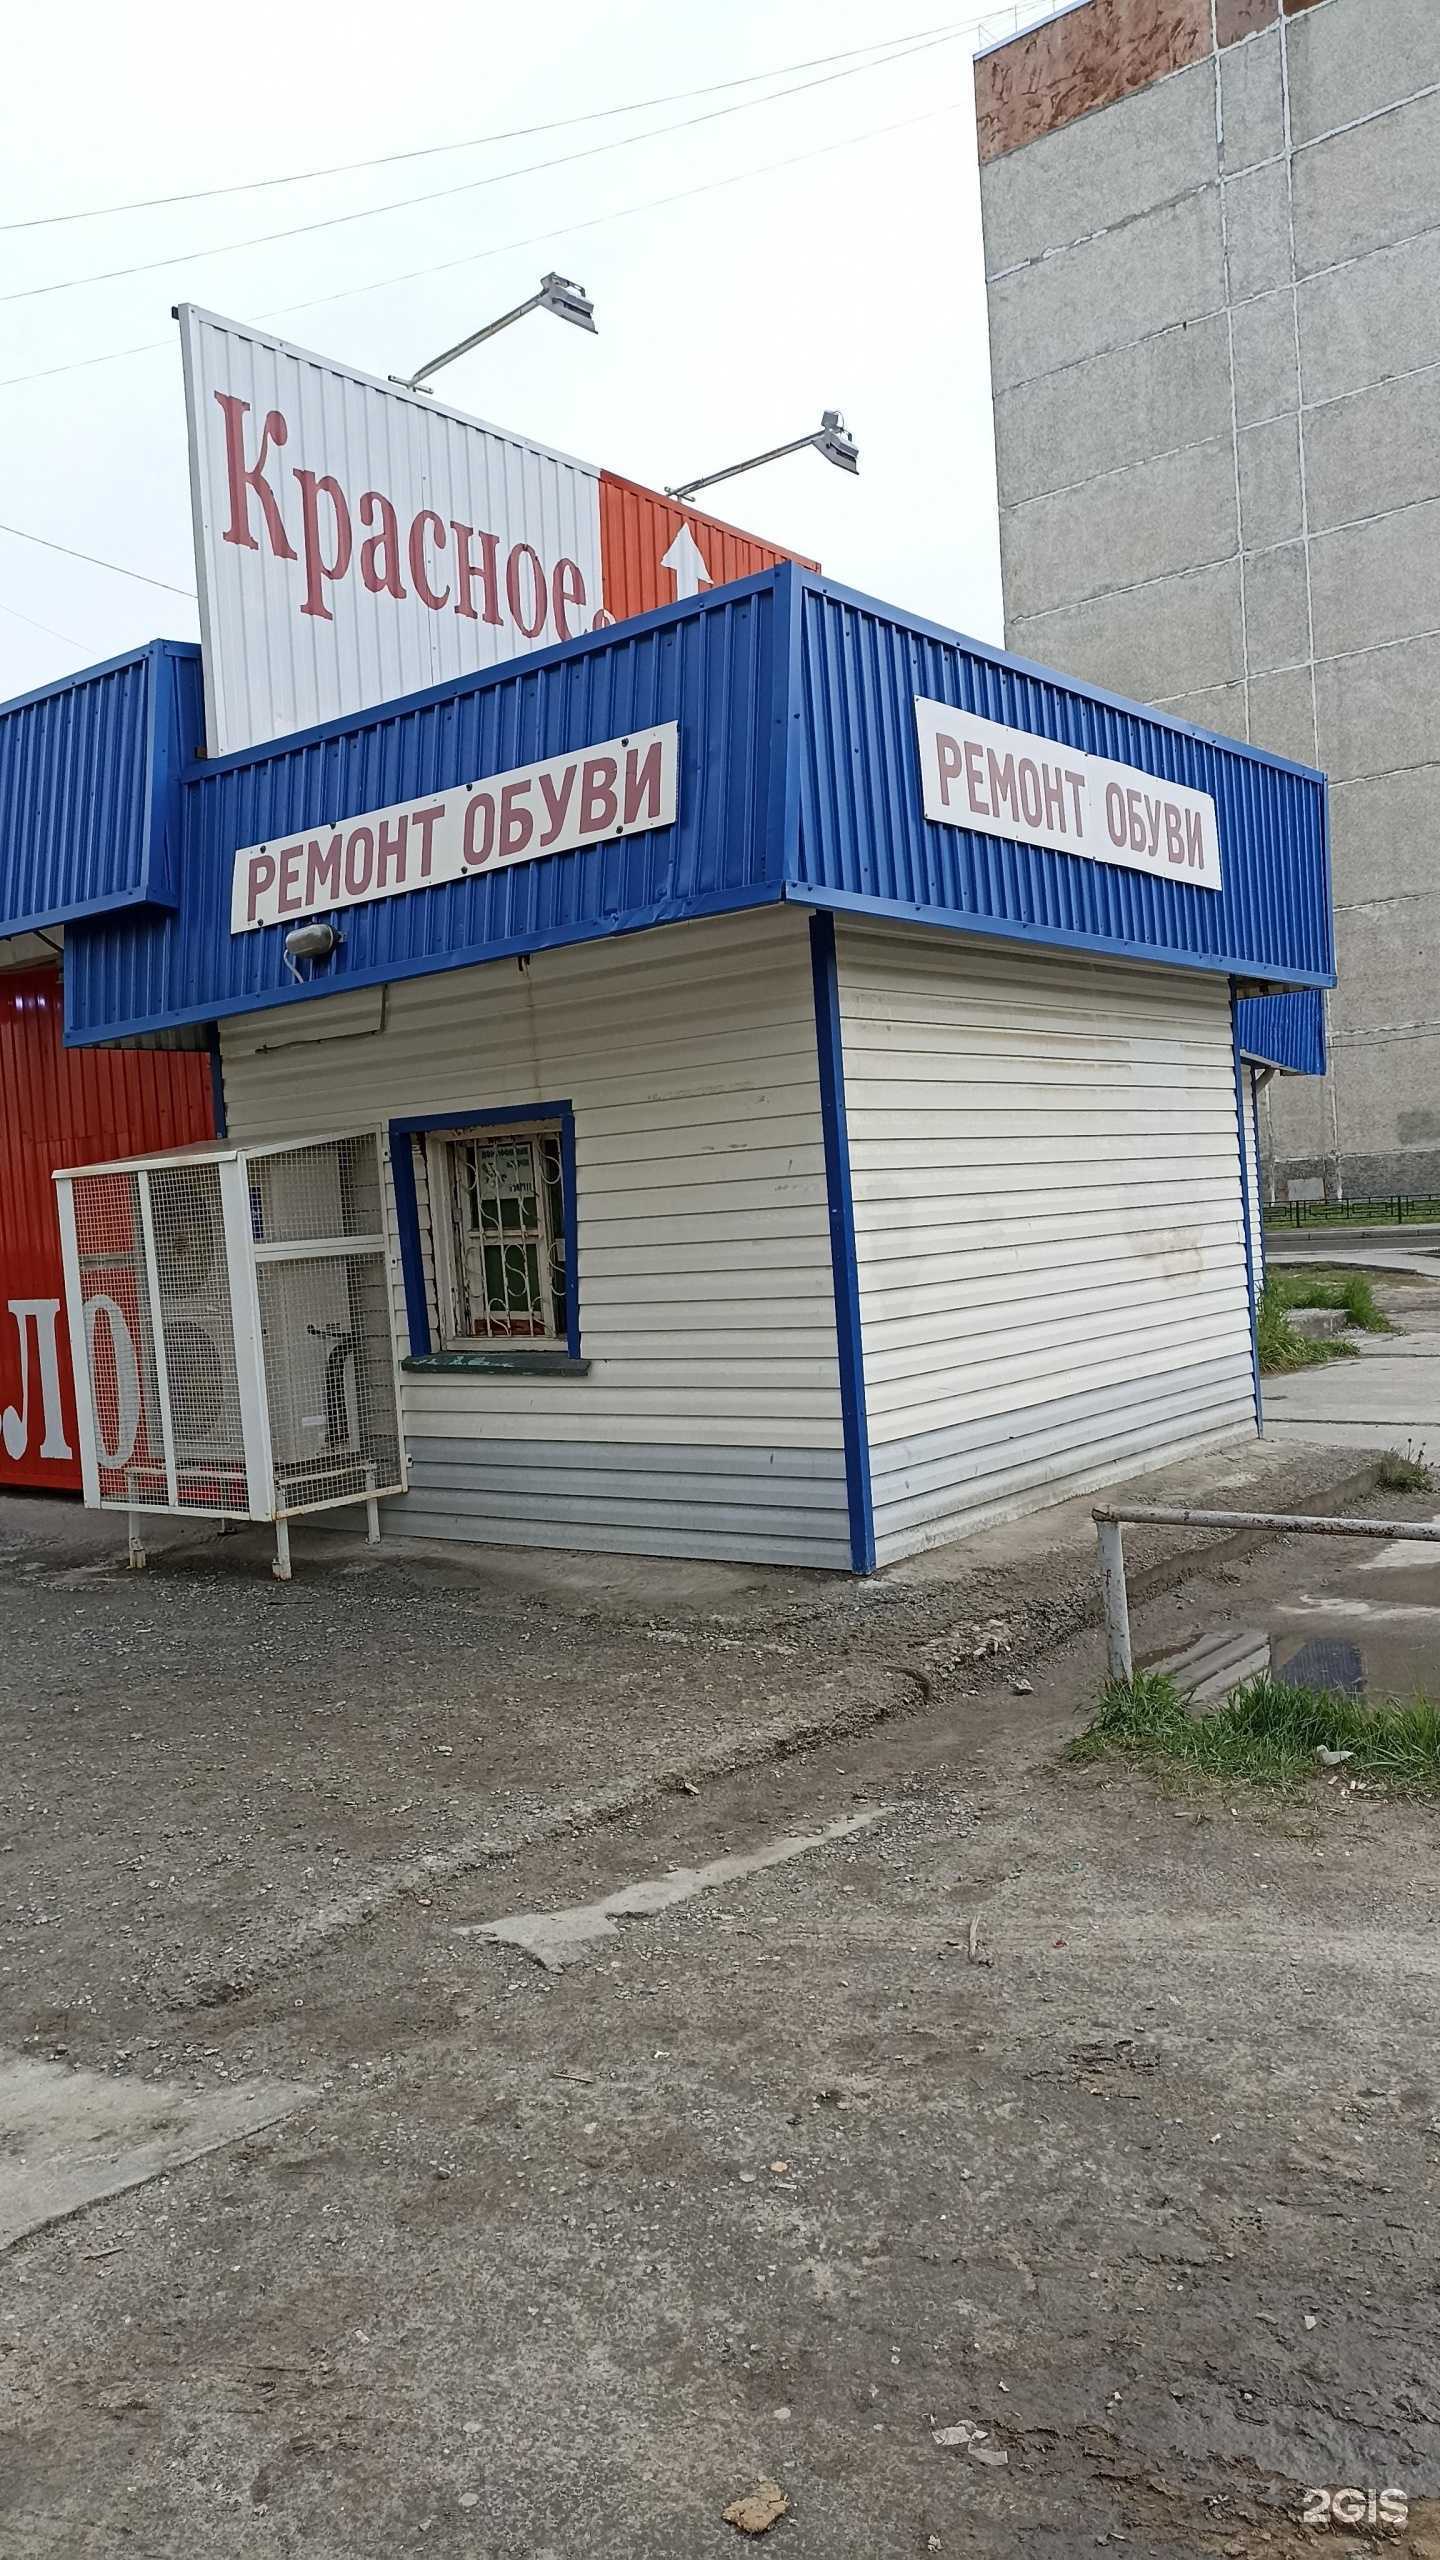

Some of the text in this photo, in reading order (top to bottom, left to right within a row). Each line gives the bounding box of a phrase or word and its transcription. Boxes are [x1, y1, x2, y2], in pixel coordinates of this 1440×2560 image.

[213, 390, 587, 642] Красное
[247, 741, 663, 922] РЕМОНТ ОБУВИ
[936, 732, 1205, 870] РЕМОНТ ОБУВИ
